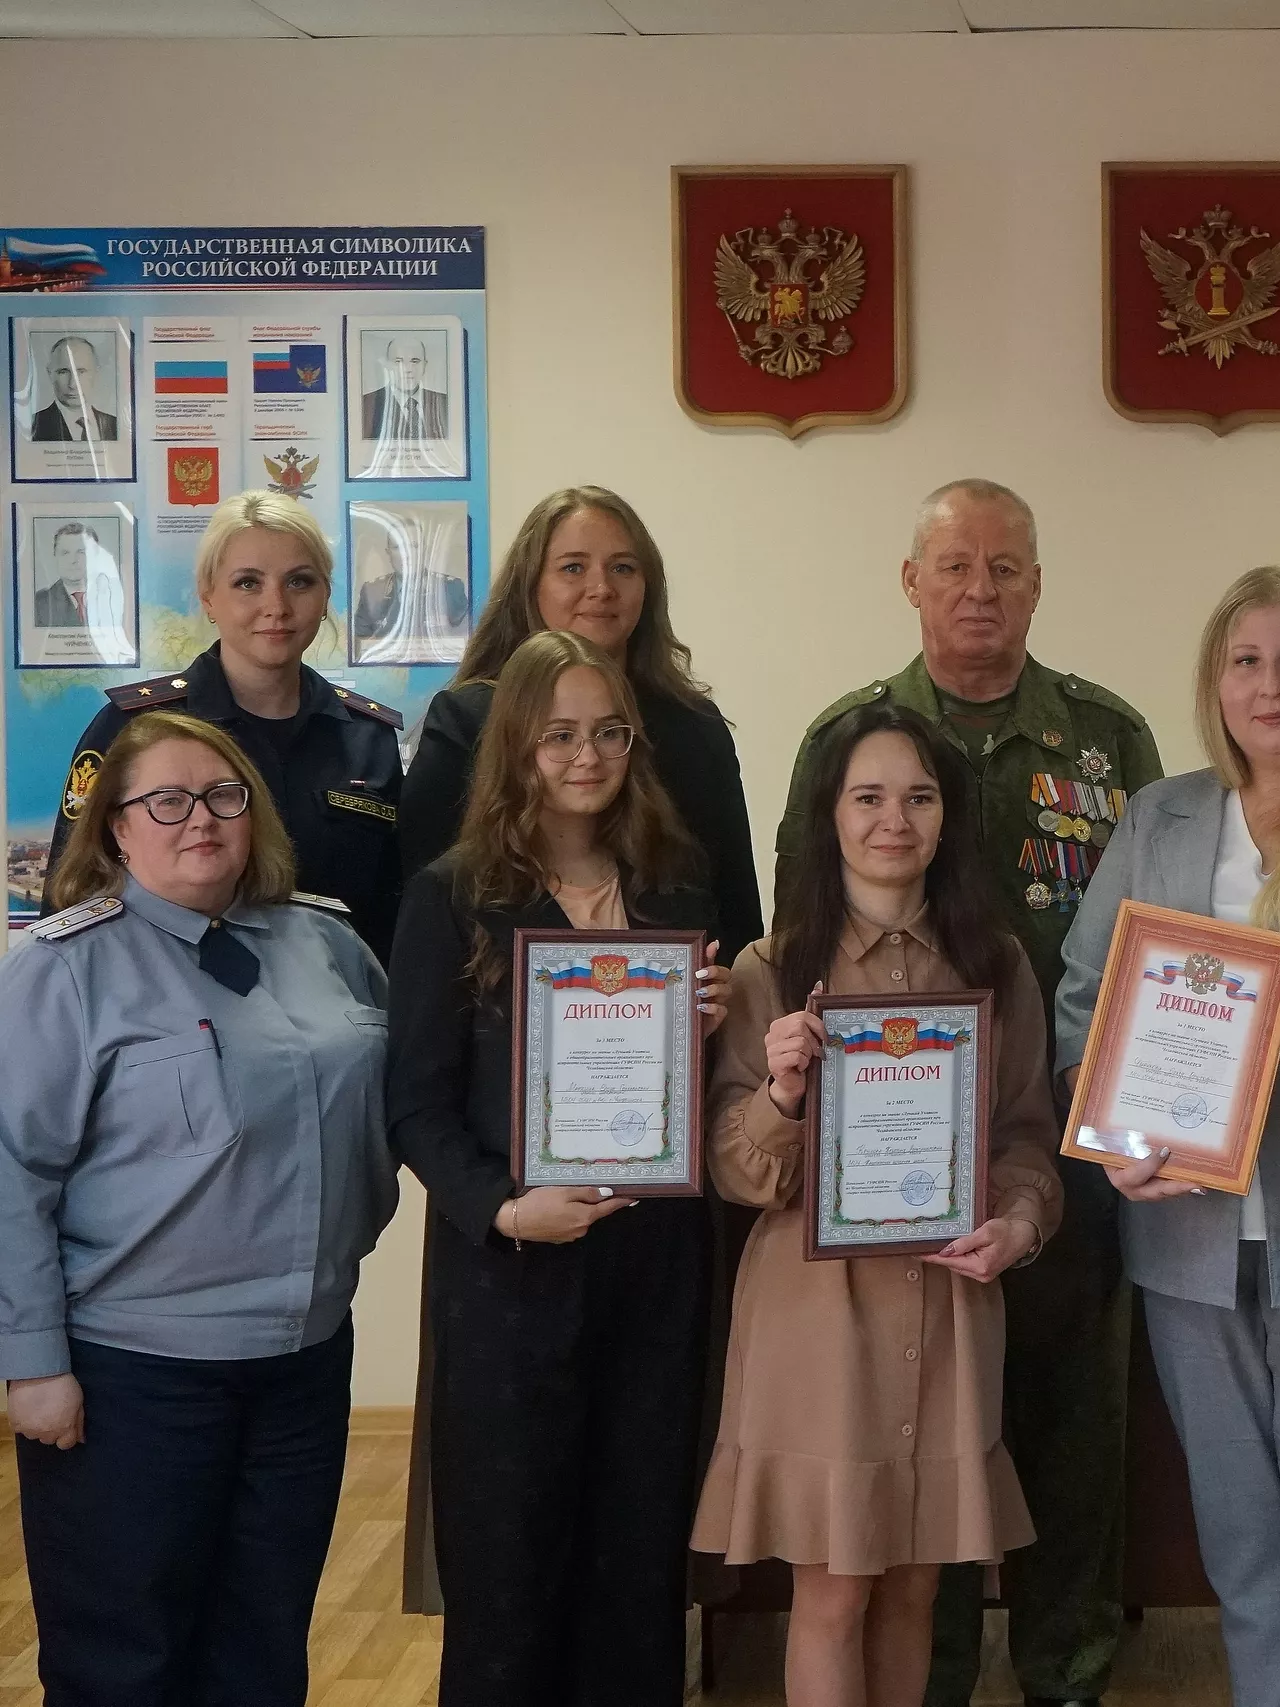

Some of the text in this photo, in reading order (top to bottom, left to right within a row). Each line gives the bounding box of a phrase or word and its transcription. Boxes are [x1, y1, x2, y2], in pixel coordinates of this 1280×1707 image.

[107, 237, 472, 258] ГОСУДАРСТВЕННАЯ СИМВОЛИКА
[142, 257, 438, 278] РОССИЙСКОЙ ФЕДЕРАЦИИ
[563, 1003, 653, 1021] ДИПЛОМ
[1156, 992, 1236, 1021] ДИПЛОМ
[1188, 1024, 1206, 1032] МЕСТО
[855, 1065, 941, 1084] ДИПЛОМ
